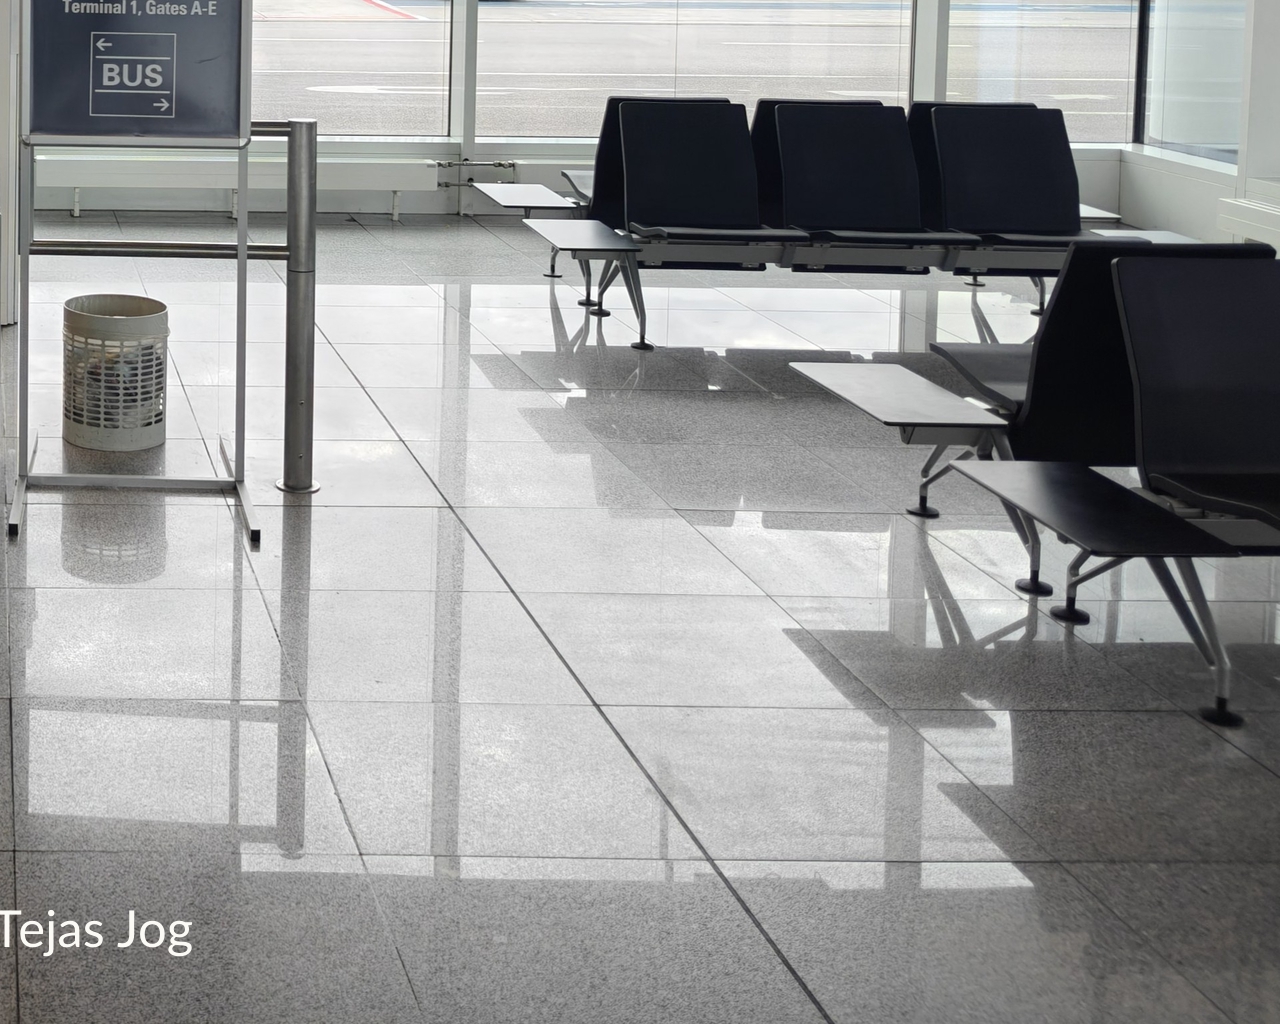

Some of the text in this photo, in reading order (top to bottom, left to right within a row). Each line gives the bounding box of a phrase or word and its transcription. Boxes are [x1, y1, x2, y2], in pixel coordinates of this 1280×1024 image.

[62, 0, 217, 16] Terminal 1, Gates A-E
[102, 64, 163, 86] BUS
